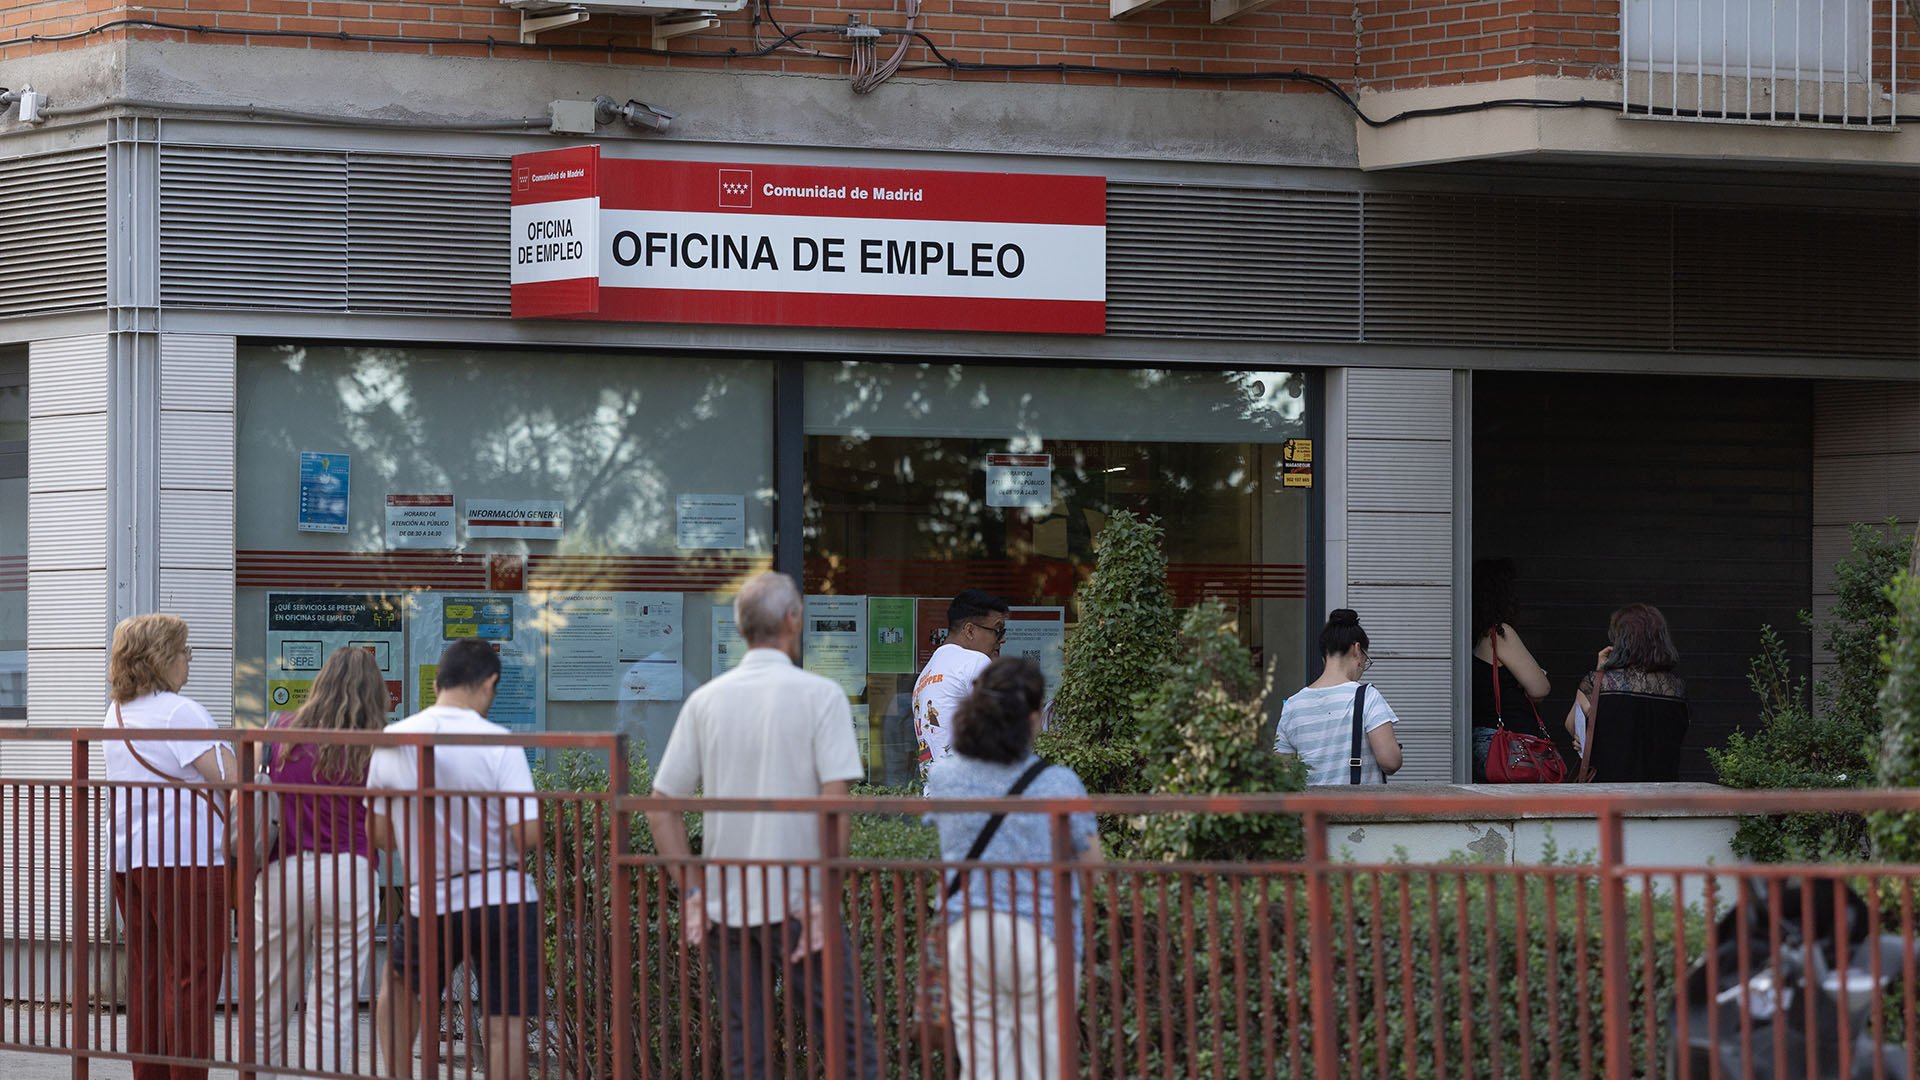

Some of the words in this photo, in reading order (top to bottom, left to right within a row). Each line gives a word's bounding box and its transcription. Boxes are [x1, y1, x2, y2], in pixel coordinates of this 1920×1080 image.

[532, 171, 559, 182] Comunidad
[560, 171, 567, 179] de
[567, 169, 584, 178] Madrid
[763, 183, 846, 199] Comunidad
[850, 187, 869, 199] de
[873, 188, 923, 201] Madrid
[527, 218, 573, 241] OFICINA
[518, 245, 533, 264] DE
[536, 240, 583, 263] EMPLEO
[612, 230, 779, 271] OFICINA
[793, 236, 846, 273] DE
[860, 239, 1026, 279] EMPLEO
[469, 509, 525, 519] INFORMACIÓN
[527, 510, 562, 520] GENERAL
[274, 603, 290, 612] ¿QUÉ
[326, 614, 355, 622] EMPLEO?
[289, 656, 314, 666] SEPE
